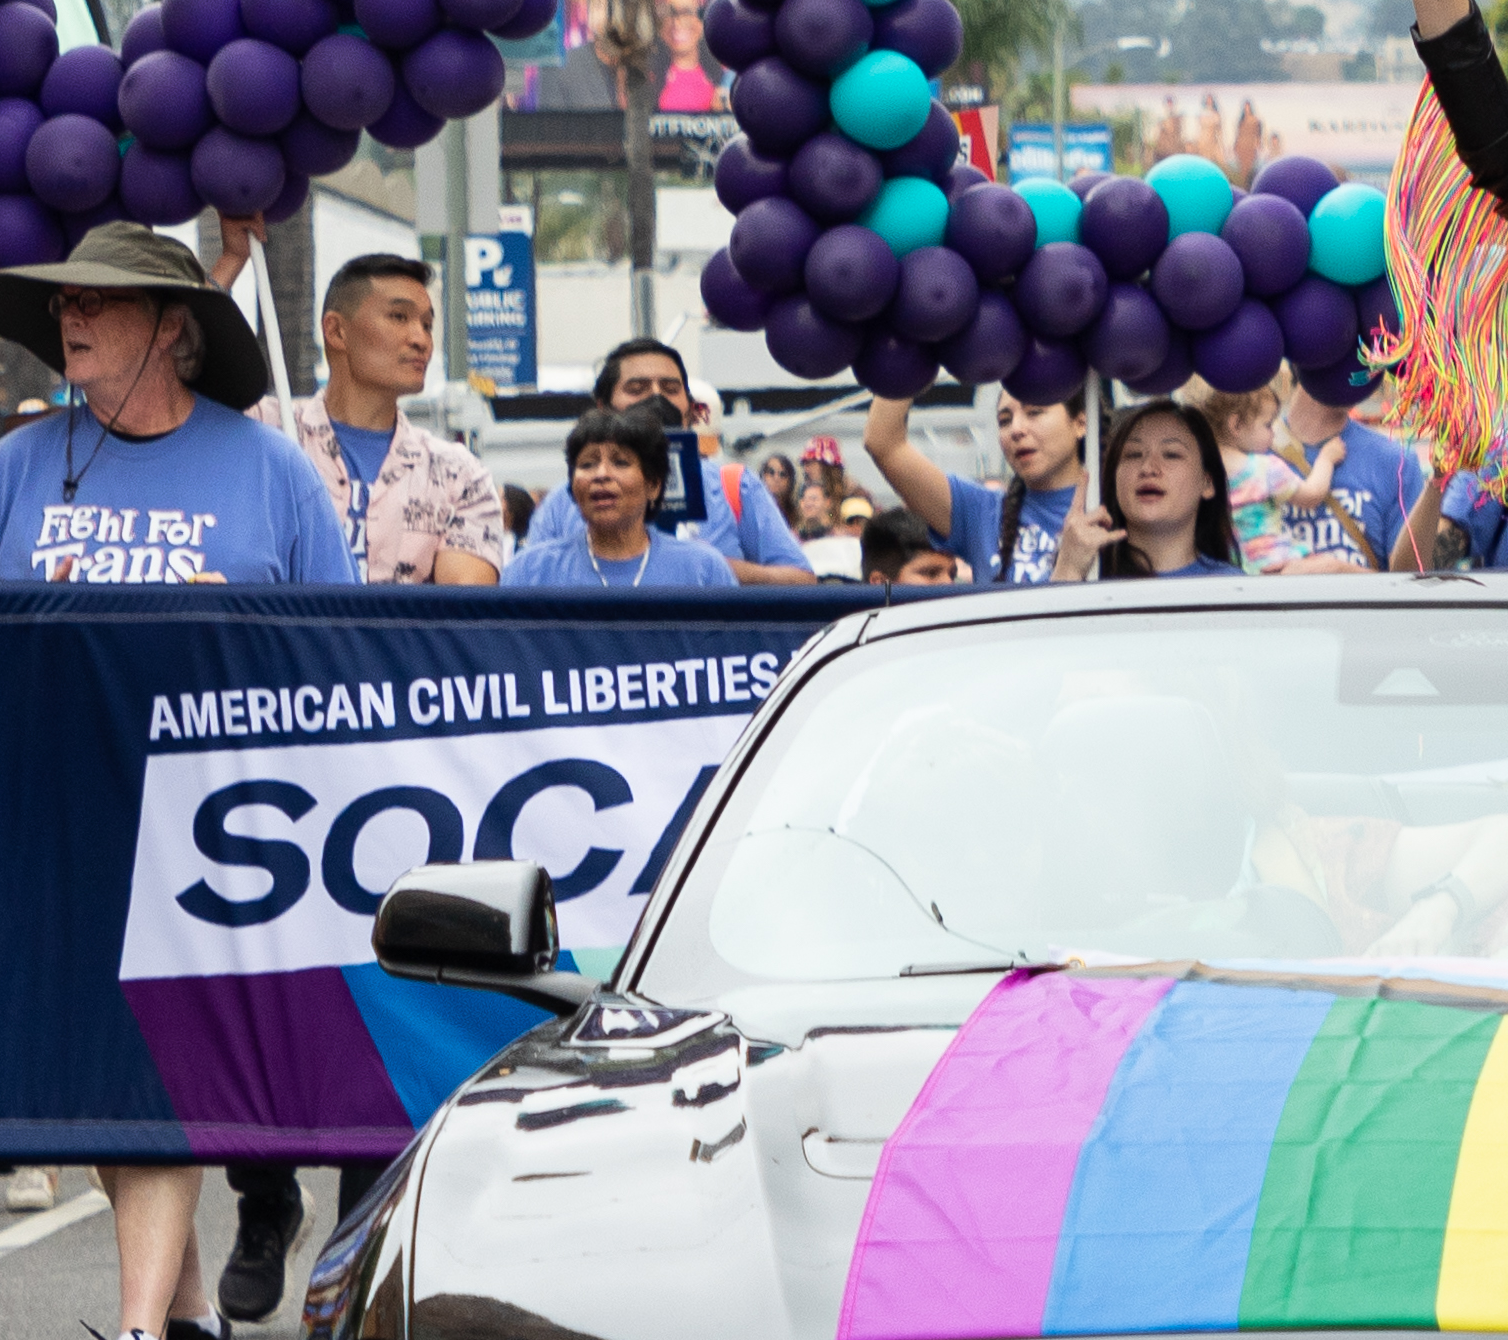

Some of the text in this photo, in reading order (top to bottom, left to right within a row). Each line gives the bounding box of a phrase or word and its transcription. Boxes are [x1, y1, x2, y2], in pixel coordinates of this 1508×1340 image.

[35, 504, 217, 548] Fight For
[31, 542, 214, 585] Trans
[149, 651, 780, 743] AMERICAN CIVIL LIBERTIES
[174, 757, 722, 929] SOC
